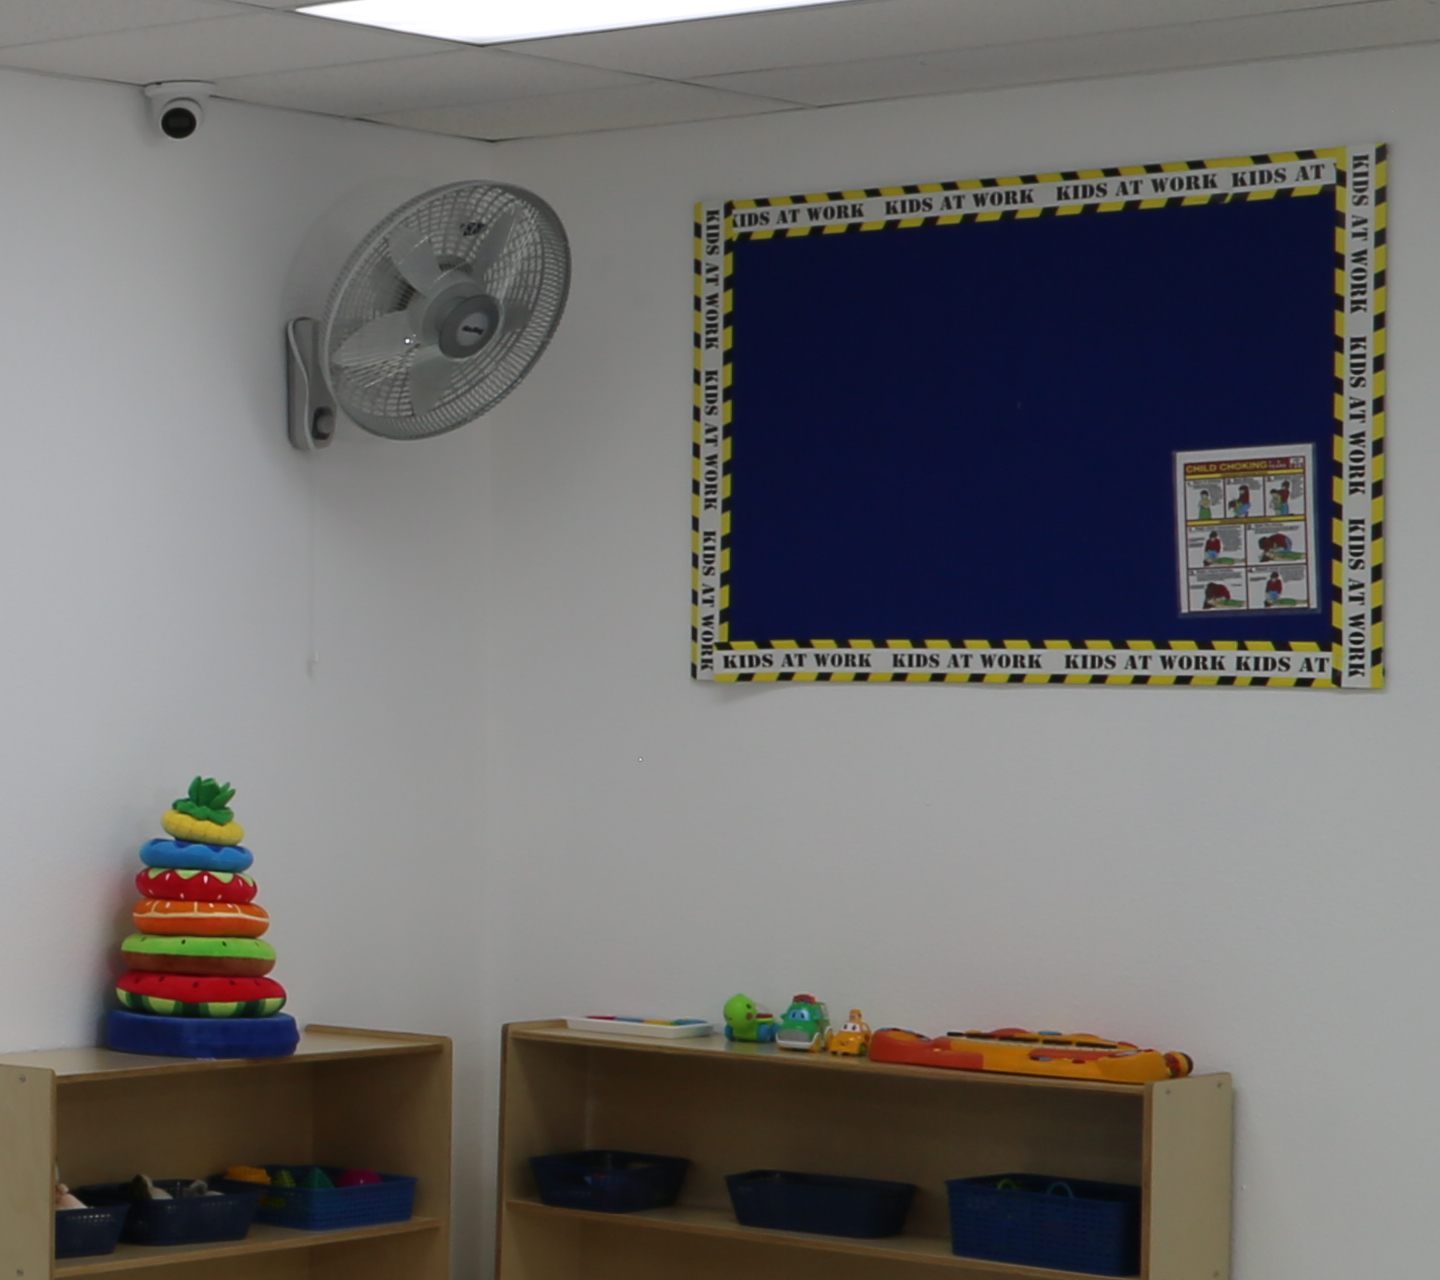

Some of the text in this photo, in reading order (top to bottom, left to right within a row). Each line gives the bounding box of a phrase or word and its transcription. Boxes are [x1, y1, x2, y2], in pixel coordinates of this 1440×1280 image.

[776, 209, 800, 225] AT
[807, 203, 864, 223] WORK
[885, 198, 933, 216] KIDS
[940, 194, 965, 211] AT
[972, 189, 1035, 208] WORK
[1056, 182, 1108, 201] KIDS
[1115, 179, 1144, 197] AT
[1152, 173, 1219, 194] WORK
[1232, 167, 1286, 188] KIDS
[1294, 164, 1326, 182] AT
[1350, 154, 1369, 314] KIDS AT WORK
[705, 209, 720, 350] KIDS AT WORK
[704, 370, 719, 510] KIDS AT WORK
[1186, 464, 1217, 473] CHILD
[1219, 461, 1267, 471] CHOKING
[1348, 336, 1367, 496] KIDS AT WORK
[701, 530, 716, 671] KIDS AT WORK
[723, 653, 1329, 672] KIDS AT WORK KIDS AT WORK KIDS AT WORK KIDS AT
[1348, 518, 1365, 678] KIDS AT WORK
